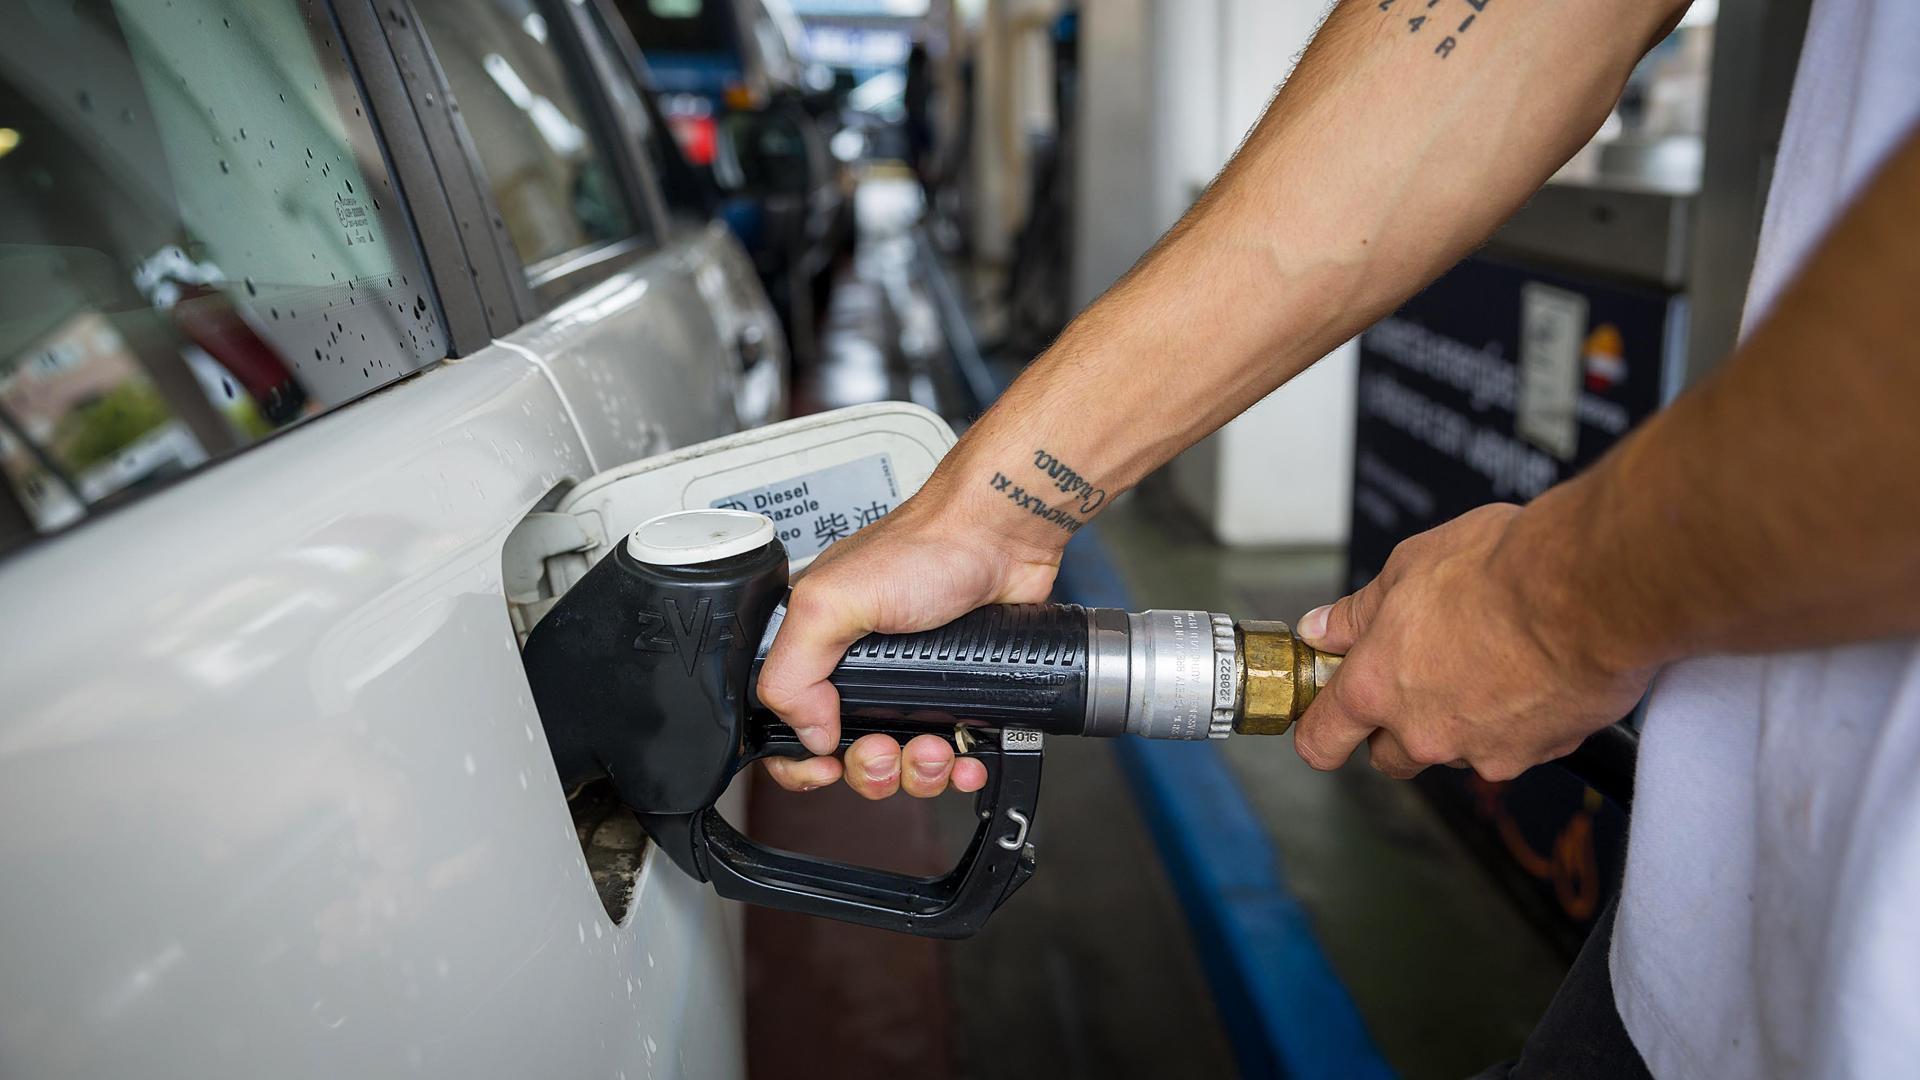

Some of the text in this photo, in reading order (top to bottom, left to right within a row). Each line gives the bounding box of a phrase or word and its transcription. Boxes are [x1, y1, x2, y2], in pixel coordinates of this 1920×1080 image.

[754, 481, 809, 508] Diesel
[1034, 450, 1105, 513] Cristina
[814, 501, 888, 548] 柴油
[1220, 657, 1231, 705] 220822
[1007, 731, 1039, 743] 2016
